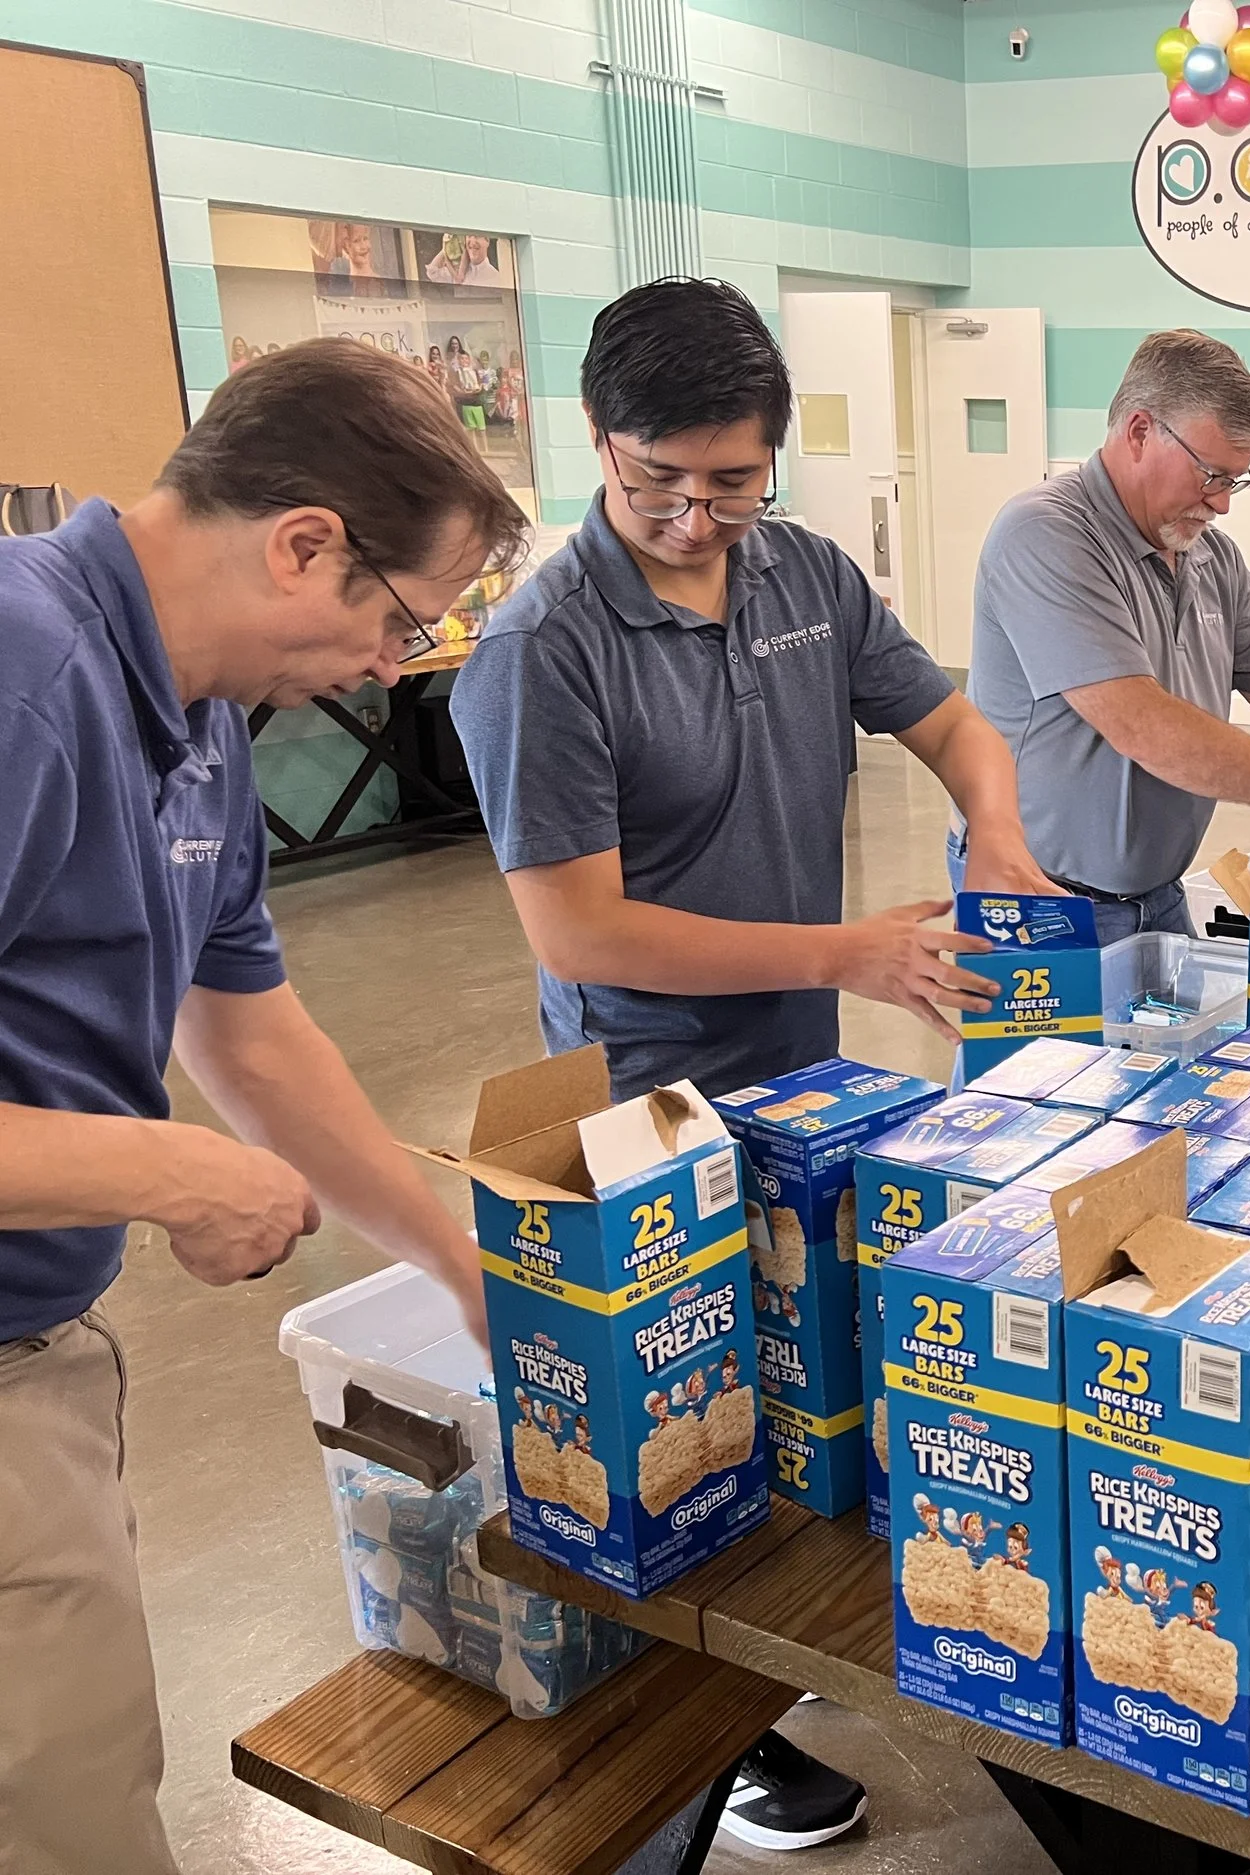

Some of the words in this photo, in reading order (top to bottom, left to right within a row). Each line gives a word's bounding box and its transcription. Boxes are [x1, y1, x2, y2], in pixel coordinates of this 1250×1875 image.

[1166, 215, 1214, 241] people
[1223, 212, 1239, 239] of
[770, 628, 808, 645] CURRENT
[809, 621, 831, 635] EDGE
[1012, 968, 1051, 999] 25
[1004, 999, 1038, 1010] LARGE
[1038, 998, 1061, 1008] SIZE
[1014, 1008, 1052, 1022] BARS
[1023, 1023, 1061, 1033] BIGGER
[515, 1200, 551, 1244] 25
[630, 1193, 677, 1250] 25
[880, 1184, 923, 1228] 25
[871, 1220, 908, 1240] LARGE
[510, 1235, 541, 1257] LARGE
[541, 1245, 562, 1265] SIZE
[520, 1253, 556, 1278] BARS
[623, 1243, 661, 1271] LARGE
[661, 1228, 688, 1252] SIZE
[636, 1248, 679, 1282] BARS
[530, 1277, 565, 1298] BIGGER
[648, 1264, 690, 1294] BIGGER
[634, 1317, 671, 1351] RICE
[669, 1283, 736, 1326] KRISPIES
[912, 1295, 964, 1346] 25
[639, 1302, 736, 1374] TREATS
[754, 1334, 804, 1371] TREA
[902, 1336, 946, 1362] LARGE
[946, 1347, 977, 1368] SIZE
[511, 1338, 536, 1361] RICE
[534, 1343, 588, 1383] KRISPIES
[780, 1366, 807, 1388] RICE
[915, 1355, 965, 1384] BARS
[1096, 1340, 1150, 1396] 25
[514, 1354, 588, 1405] TREATS
[927, 1378, 976, 1404] BIGGER
[1085, 1382, 1131, 1410] LARGE
[1131, 1398, 1164, 1419] SIZE
[773, 1417, 806, 1443] BARS
[948, 1412, 991, 1436] Kellogg's
[1098, 1401, 1151, 1434] BARS
[767, 1428, 787, 1446] SIZE
[786, 1437, 815, 1459] LARGE
[908, 1422, 948, 1449] RICE
[949, 1430, 1034, 1474] KRISPIES
[1110, 1430, 1162, 1457] BIGGER
[776, 1446, 810, 1490] 25
[911, 1443, 1030, 1502] TREATS
[1132, 1464, 1176, 1489] Kellogg's
[674, 1483, 735, 1527] Original
[1090, 1472, 1131, 1500] RICE
[1133, 1480, 1222, 1531] KRISPIES
[541, 1508, 594, 1543] Original
[1094, 1493, 1219, 1562] TREATS
[938, 1641, 1012, 1677] Original
[1119, 1700, 1196, 1741] Original
